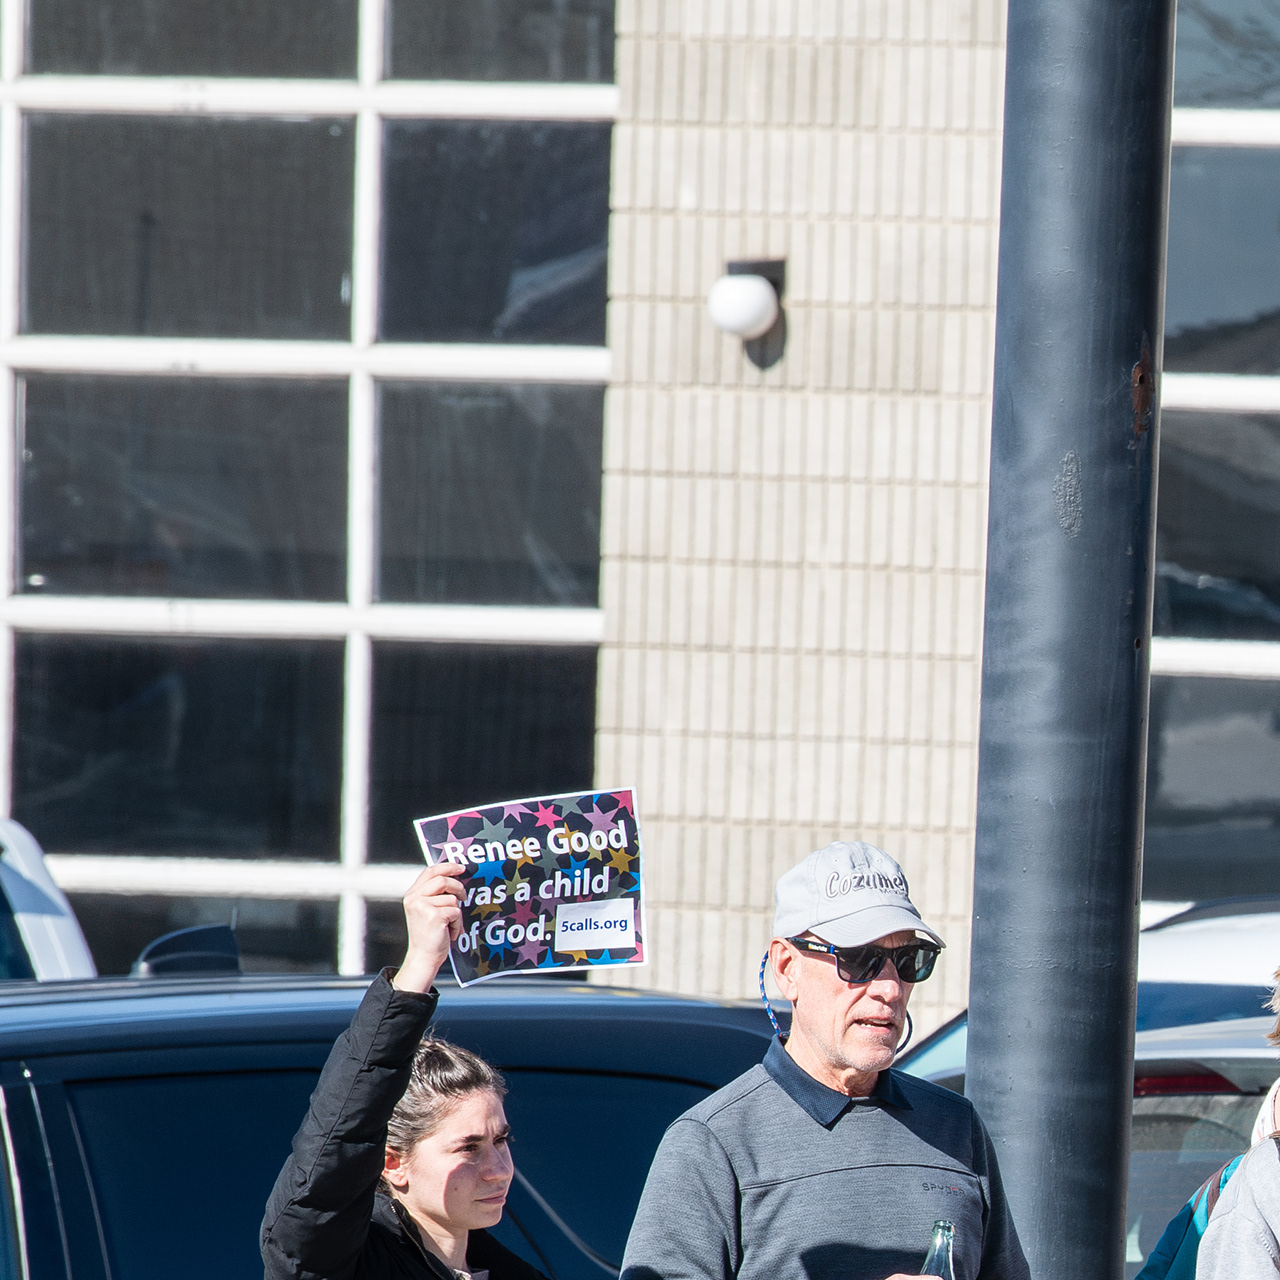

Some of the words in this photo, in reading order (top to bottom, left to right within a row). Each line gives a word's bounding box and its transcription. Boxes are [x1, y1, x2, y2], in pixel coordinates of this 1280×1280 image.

[443, 836, 541, 867] Renee
[547, 820, 628, 855] Good
[457, 884, 507, 909] was
[514, 883, 531, 903] a
[539, 866, 610, 898] child
[457, 921, 480, 953] of
[485, 914, 552, 946] God.
[561, 916, 628, 933] 5calls.org
